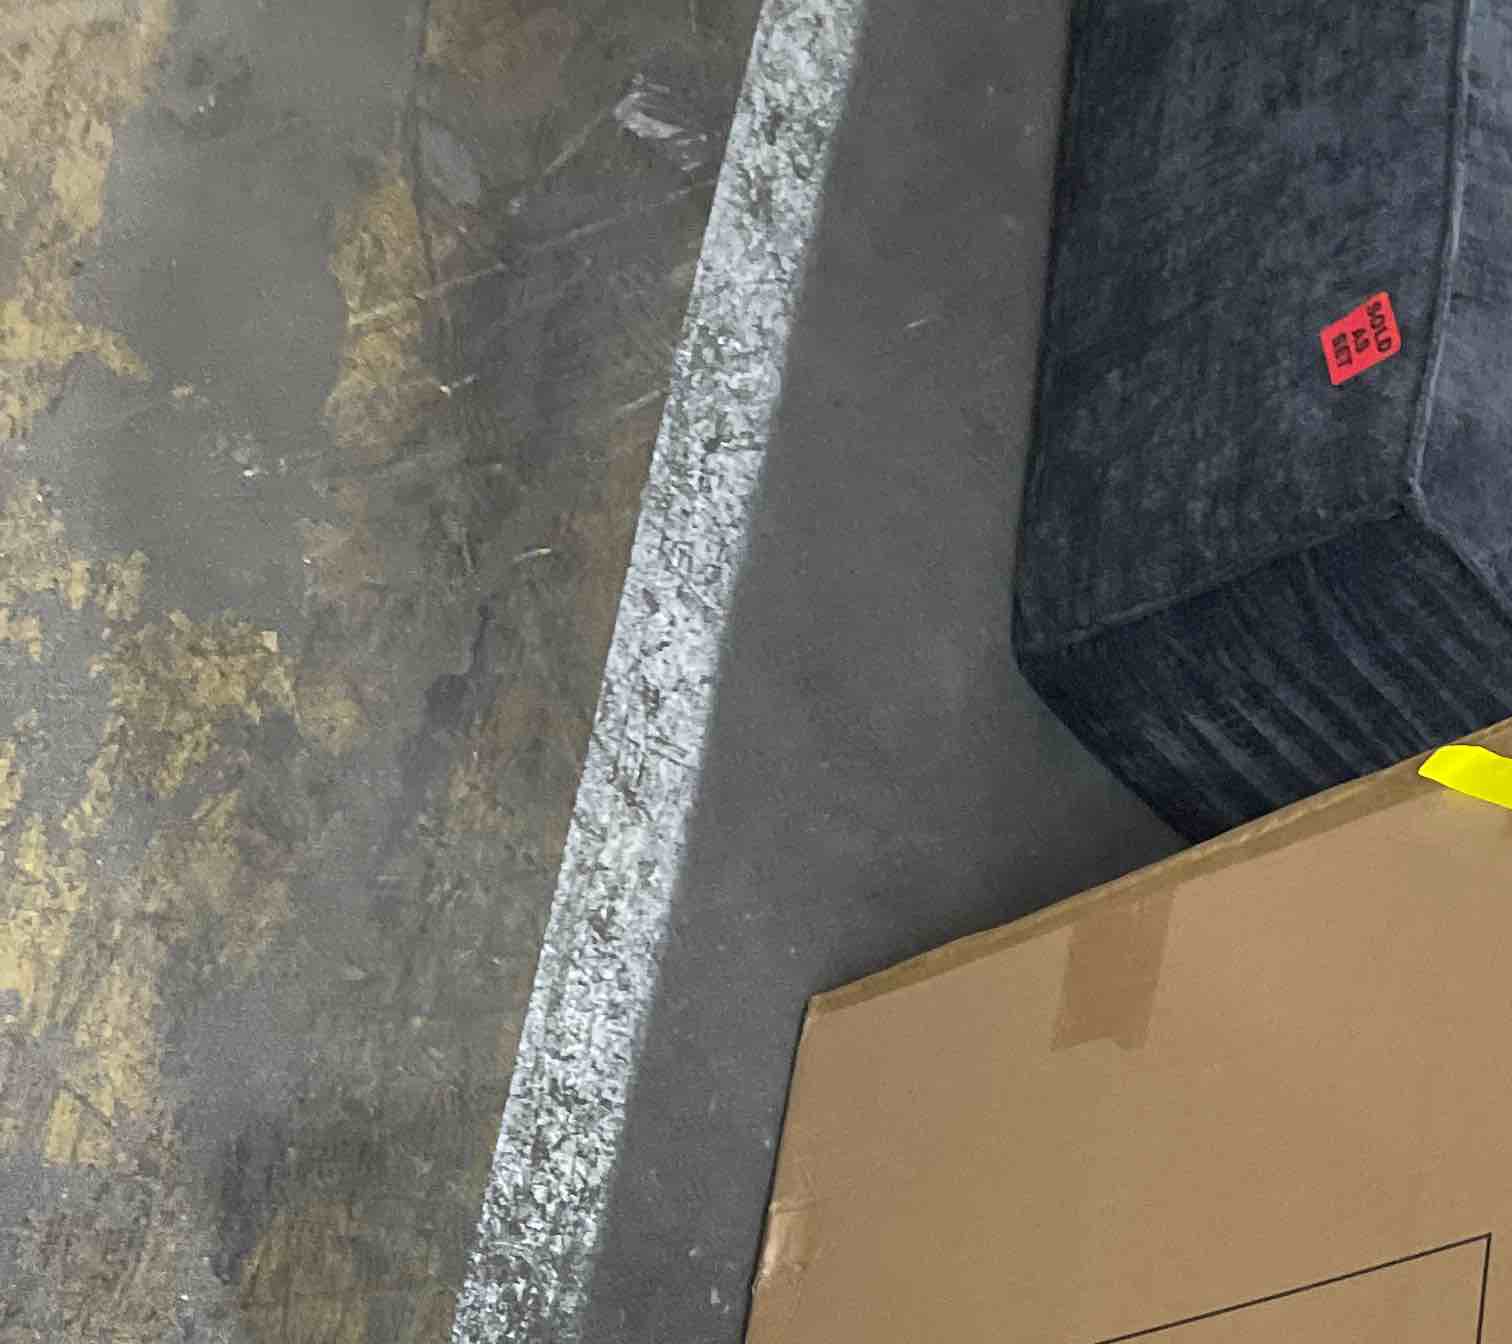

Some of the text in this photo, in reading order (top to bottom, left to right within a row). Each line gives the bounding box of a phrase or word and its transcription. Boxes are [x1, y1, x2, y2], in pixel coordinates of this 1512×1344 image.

[1352, 328, 1370, 353] AS
[1367, 301, 1393, 352] SOLD
[1332, 333, 1352, 367] SET
